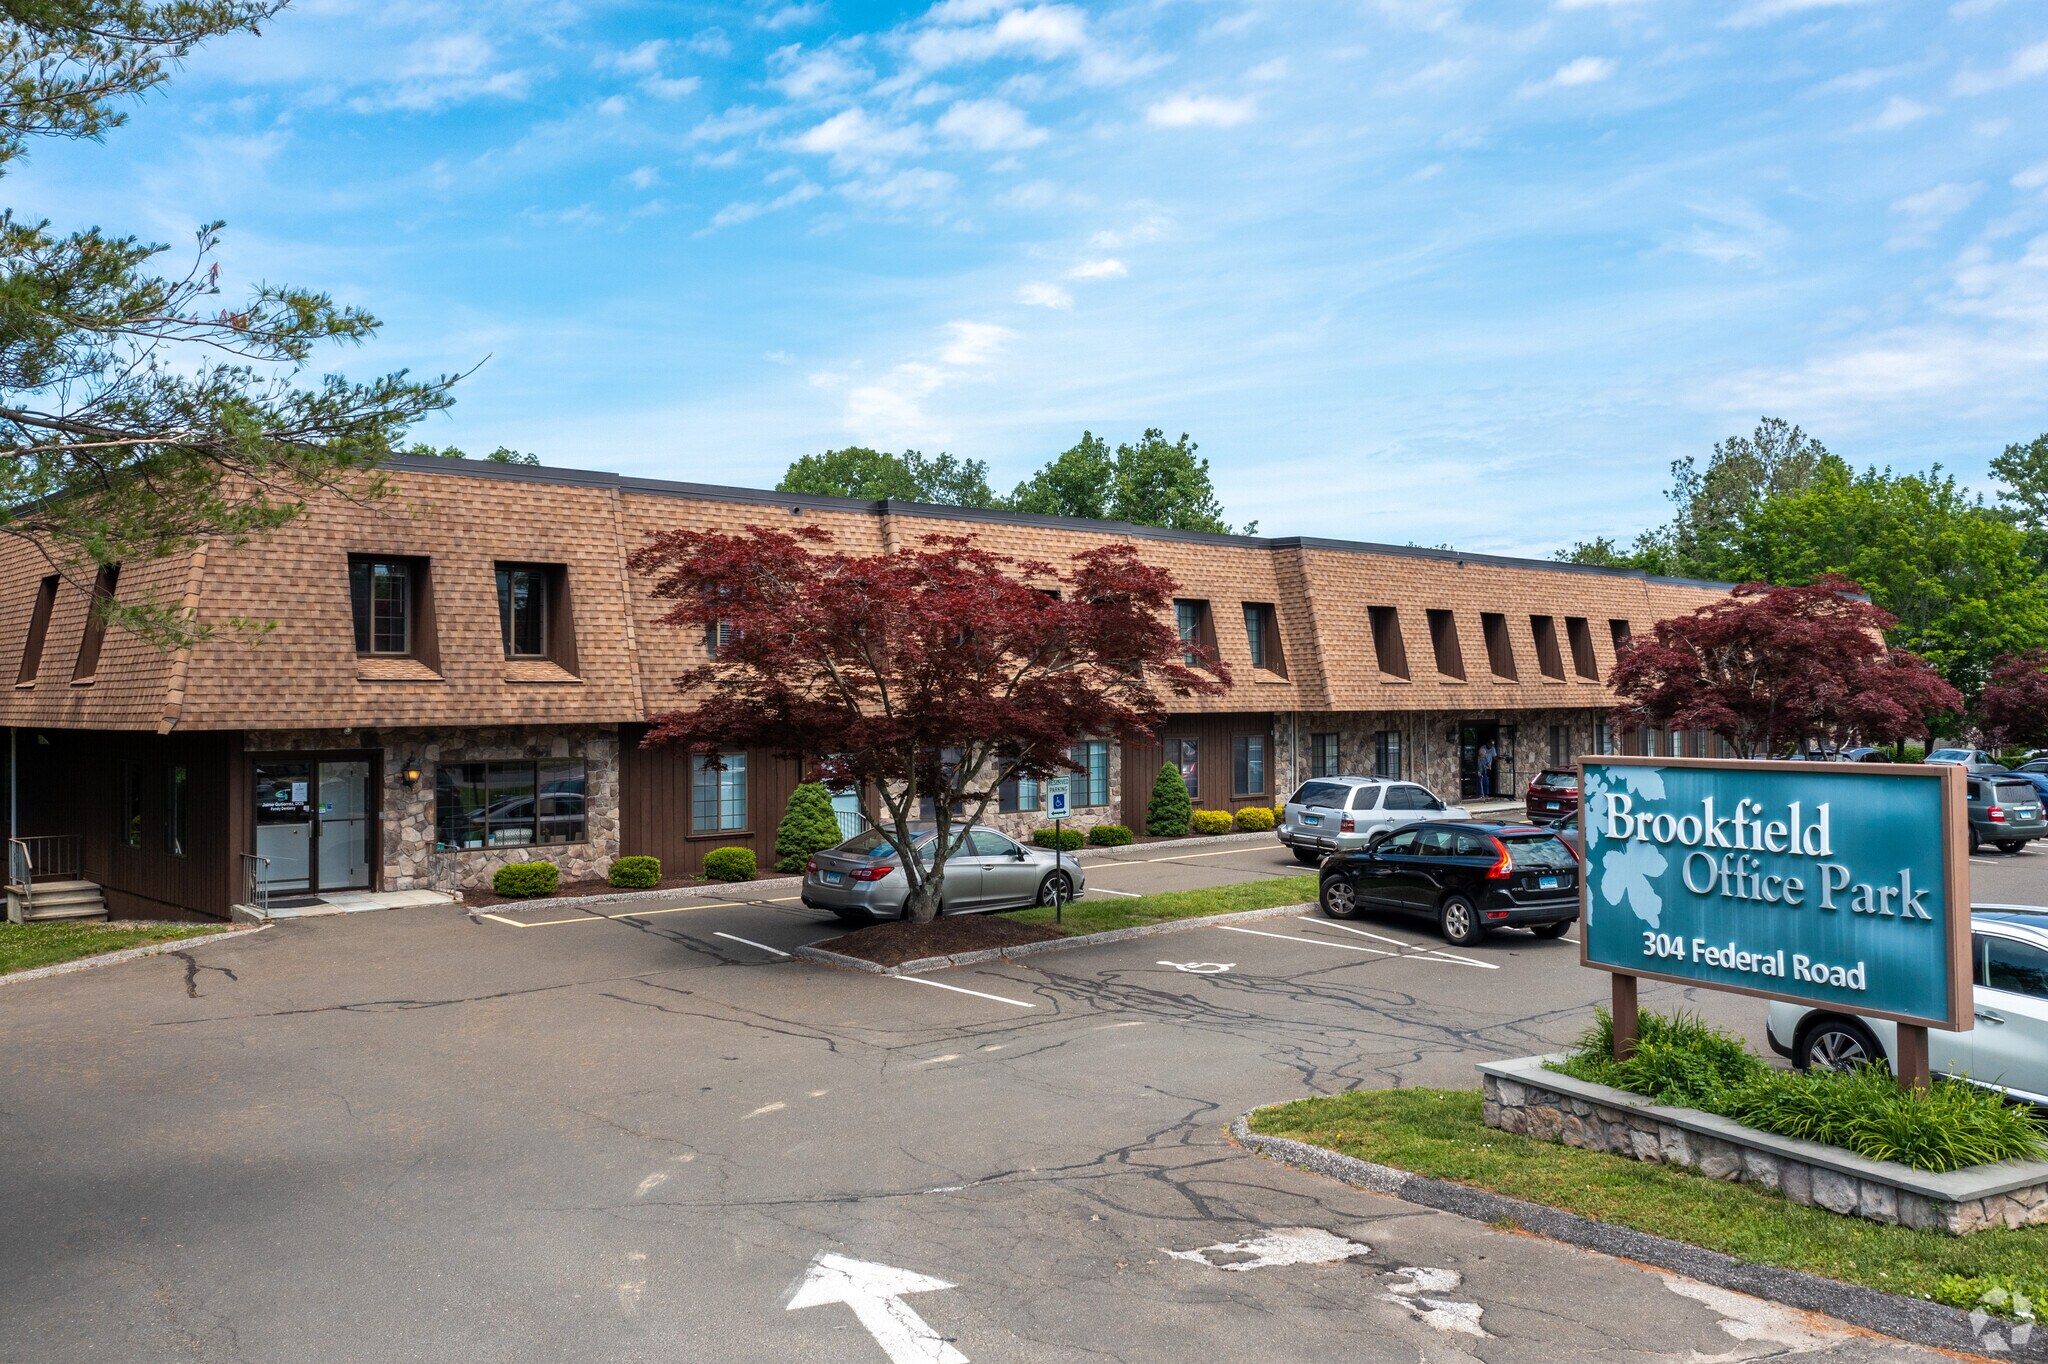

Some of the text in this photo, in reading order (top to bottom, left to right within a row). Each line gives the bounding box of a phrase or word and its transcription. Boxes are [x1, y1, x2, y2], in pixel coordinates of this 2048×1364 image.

[1603, 793, 1833, 857] Brookfield
[1682, 851, 1932, 920] Office Park
[1643, 931, 1866, 991] 304 Federal Road
